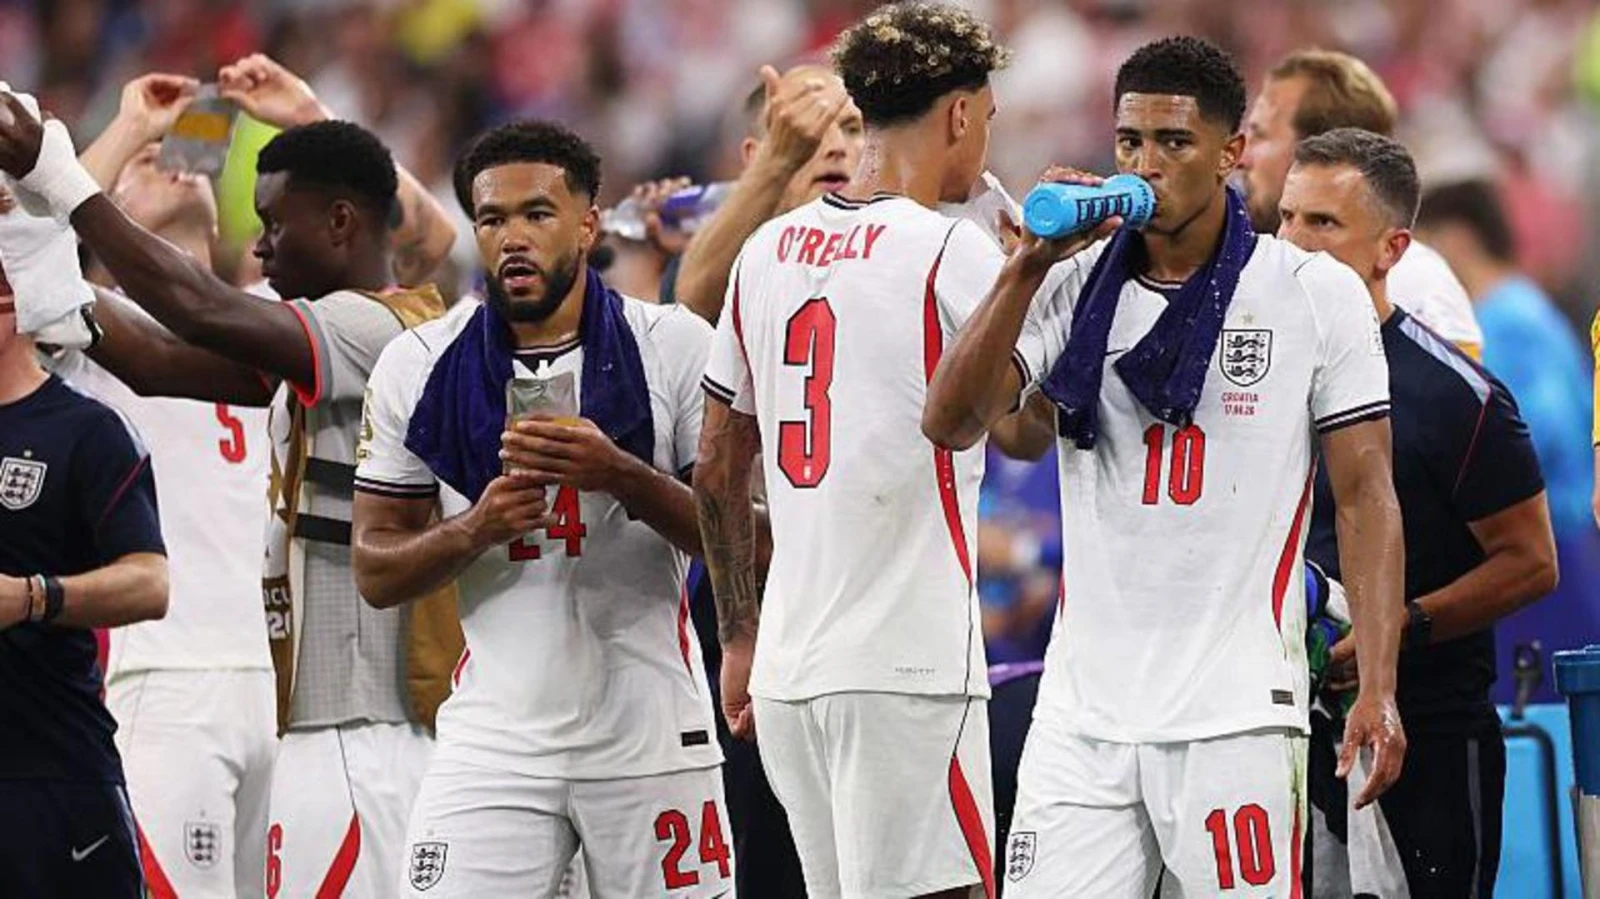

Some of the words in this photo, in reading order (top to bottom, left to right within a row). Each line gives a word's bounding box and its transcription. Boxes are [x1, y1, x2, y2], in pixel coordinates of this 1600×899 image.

[777, 297, 836, 489] 3
[1221, 391, 1259, 403] CROATIA
[1141, 421, 1206, 505] 10
[654, 800, 731, 890] 24
[1205, 803, 1276, 889] 10
